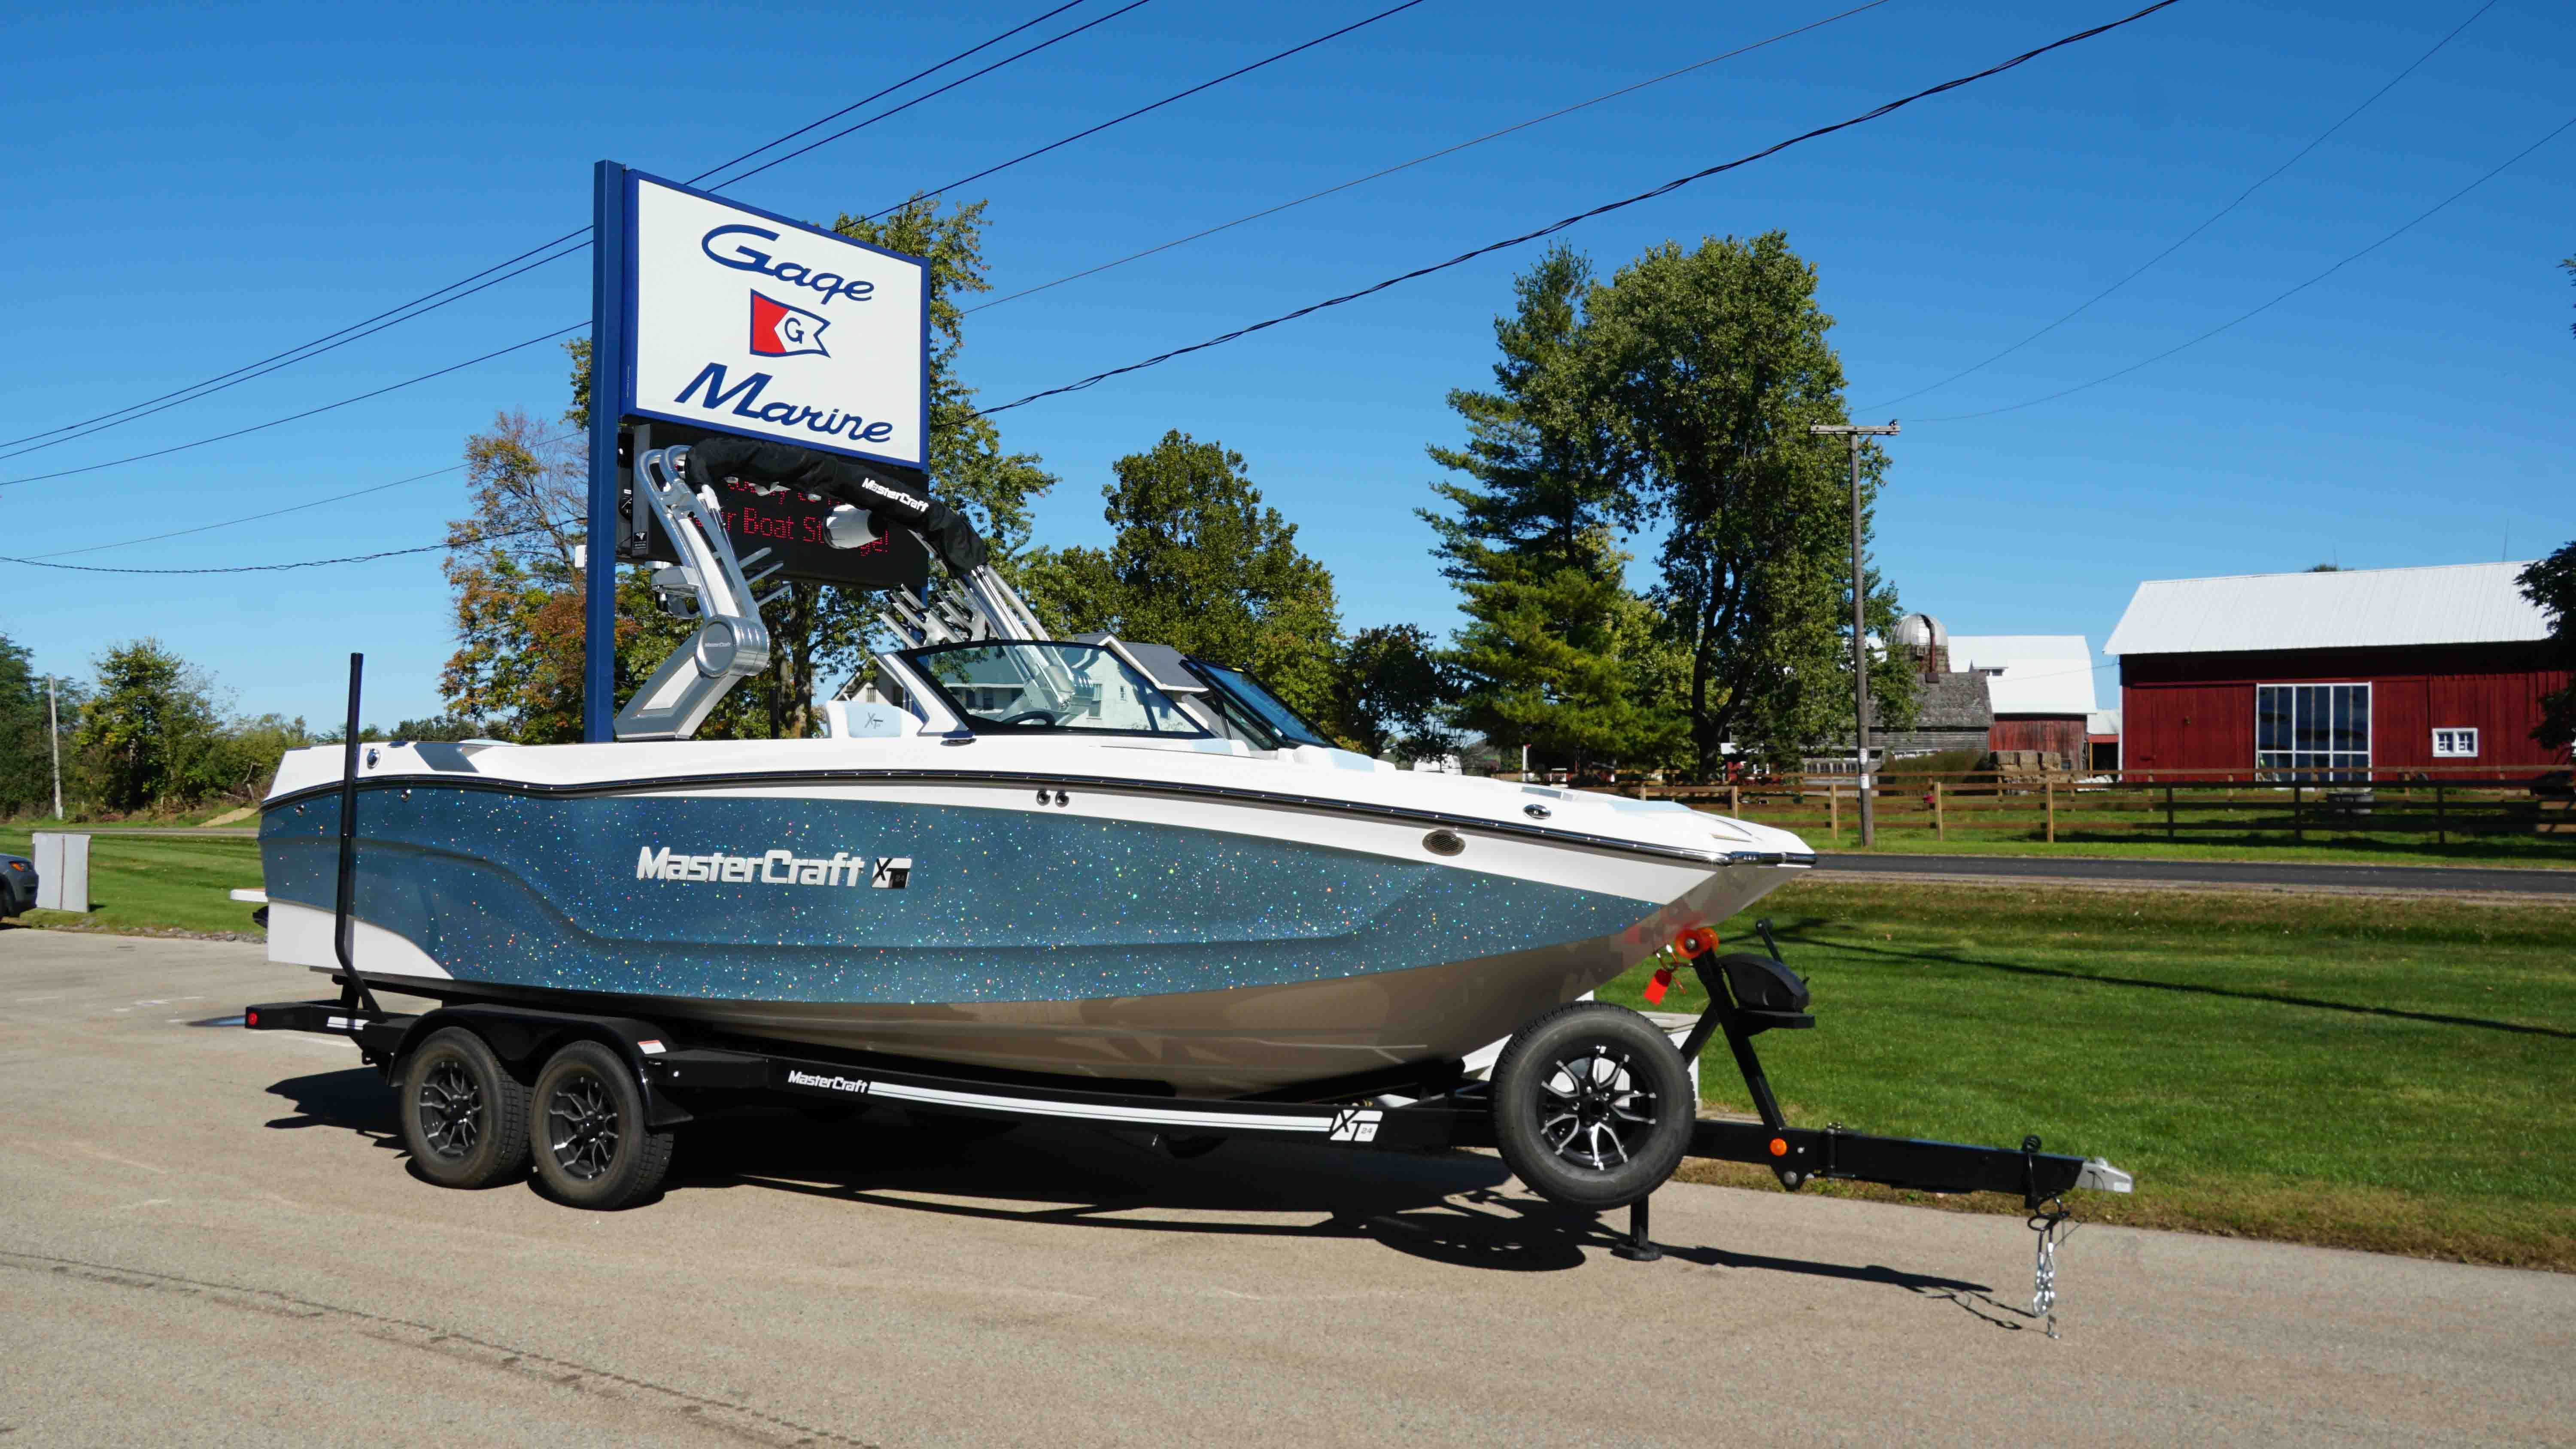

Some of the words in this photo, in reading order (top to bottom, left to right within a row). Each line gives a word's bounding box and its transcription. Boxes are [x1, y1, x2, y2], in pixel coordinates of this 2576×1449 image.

[702, 224, 875, 305] Gage
[784, 317, 804, 344] G
[674, 362, 893, 443] Marine
[862, 477, 929, 512] MasterCraft
[744, 507, 794, 539] Boat
[636, 846, 865, 887] MasterCraft
[788, 1070, 868, 1093] MasterCraft
